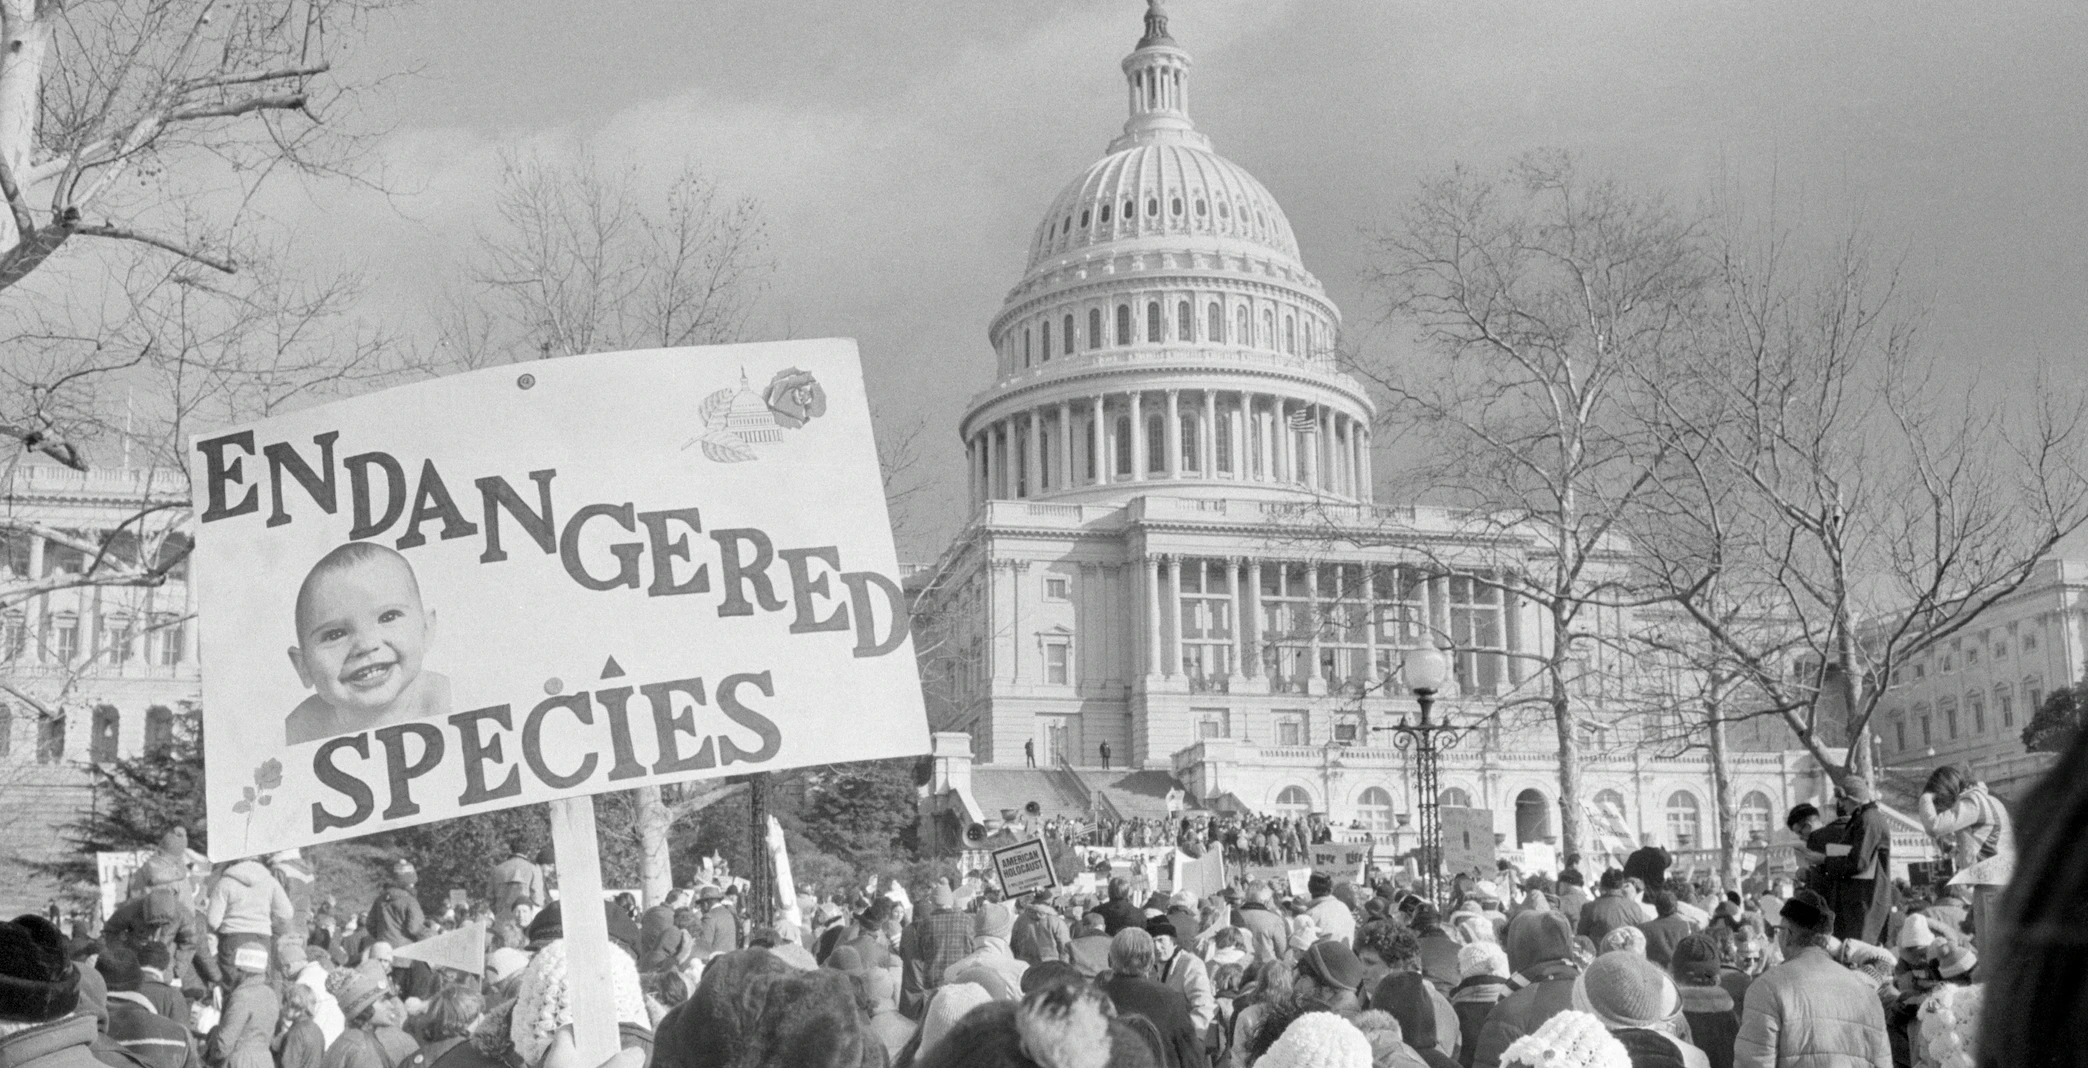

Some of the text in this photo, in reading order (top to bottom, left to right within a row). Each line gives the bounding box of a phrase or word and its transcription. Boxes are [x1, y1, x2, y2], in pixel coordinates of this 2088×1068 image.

[197, 430, 910, 658] ENDANGERED
[311, 670, 782, 834] SPECIES
[1002, 850, 1039, 868] AMERICAN
[1003, 859, 1043, 878] HOLOCAUST
